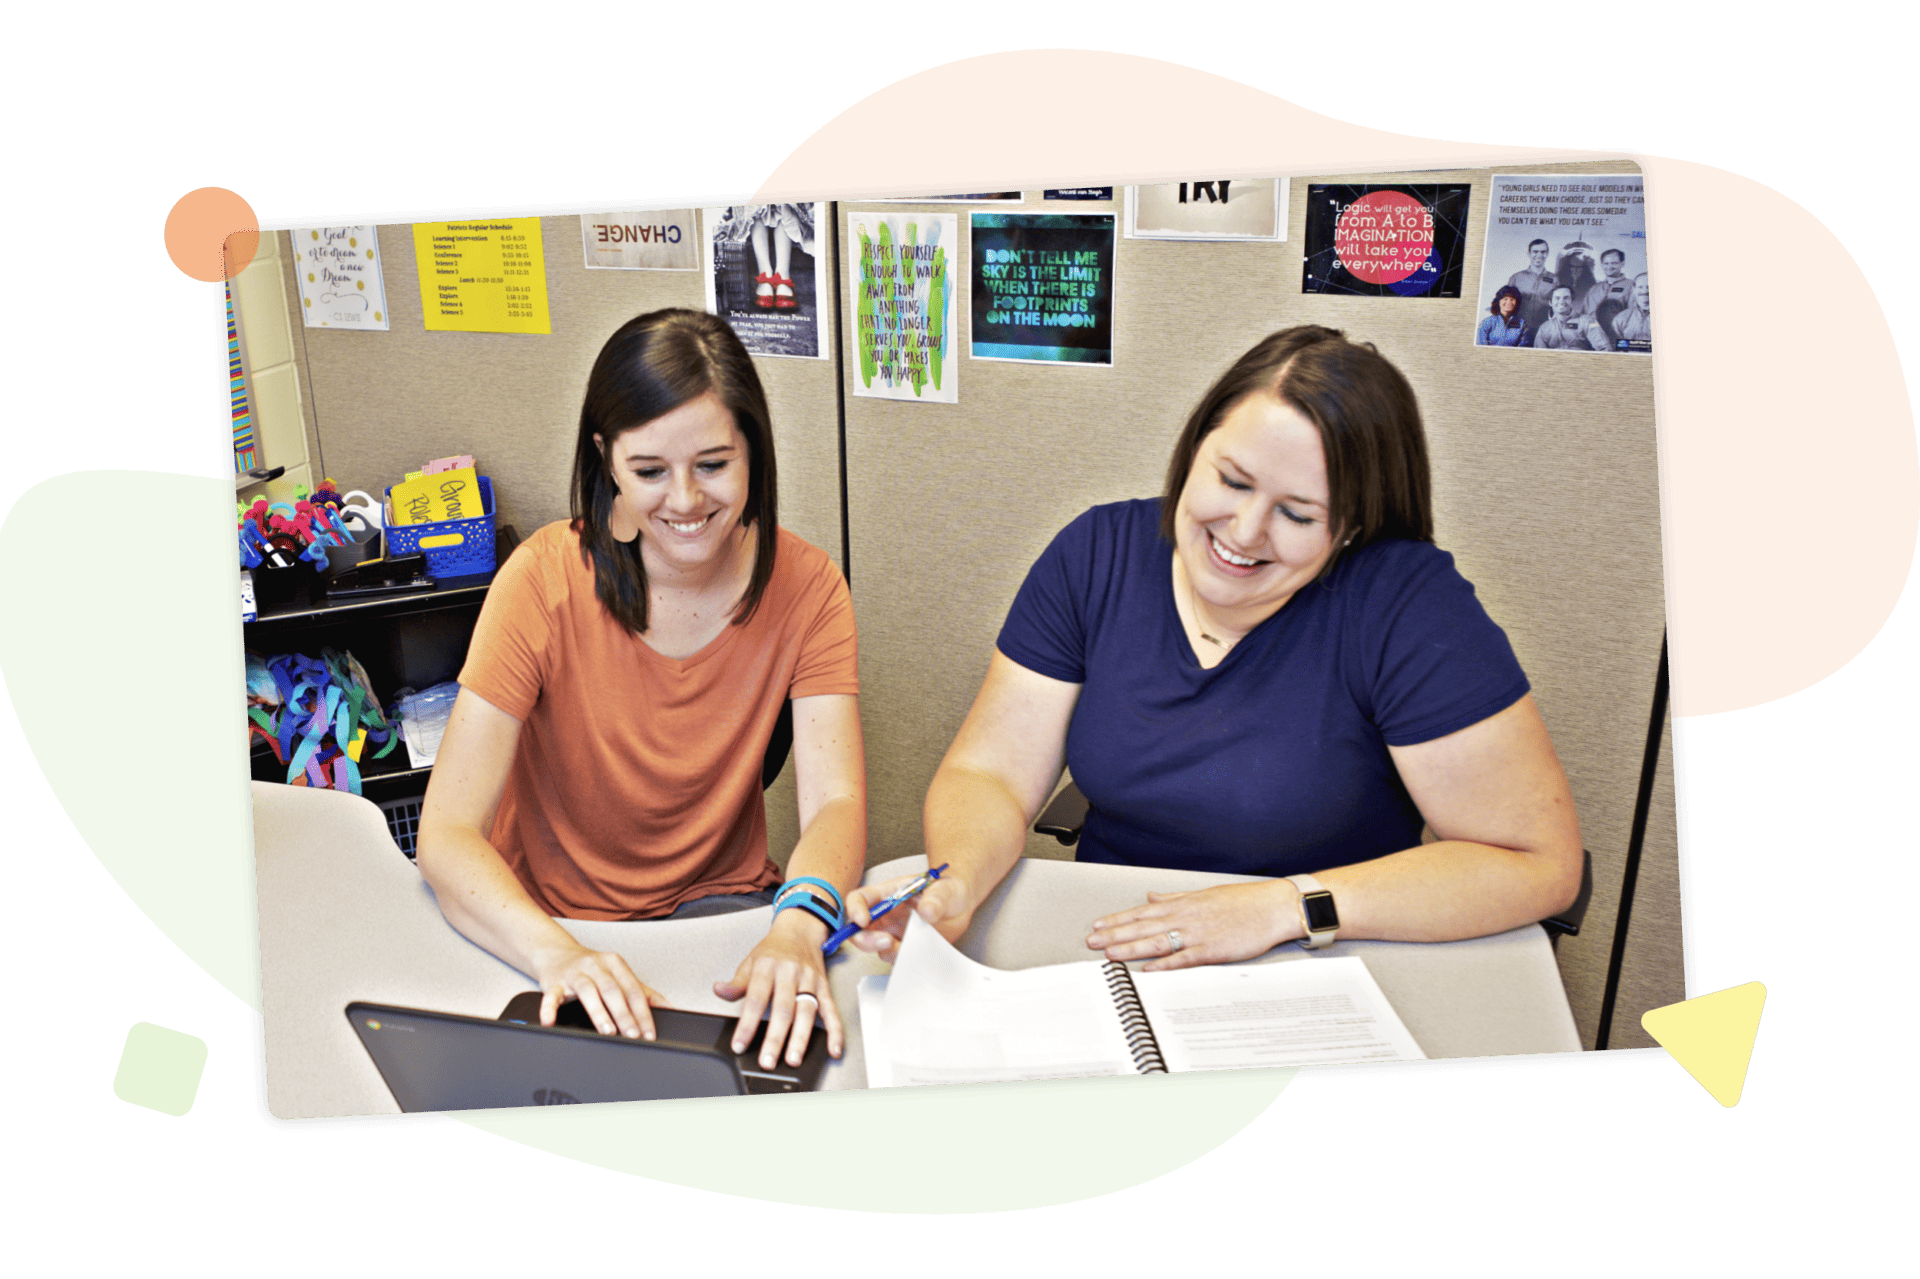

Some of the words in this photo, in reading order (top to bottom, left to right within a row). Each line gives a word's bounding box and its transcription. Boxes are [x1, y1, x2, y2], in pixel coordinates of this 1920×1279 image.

[1522, 184, 1540, 192] GIRLS
[1541, 184, 1558, 192] NEED
[1560, 184, 1568, 192] TO
[1568, 184, 1580, 192] SEE
[1582, 184, 1598, 192] ROLE
[1598, 184, 1625, 192] MODELS
[1626, 184, 1634, 192] IN
[1500, 195, 1528, 203] CAREERS
[1529, 195, 1545, 203] THEY
[1546, 195, 1560, 203] MAY
[1588, 196, 1604, 204] JUST
[1604, 196, 1614, 204] SO
[1614, 196, 1632, 204] THEY
[1374, 204, 1392, 212] will
[1394, 205, 1412, 215] get
[1414, 206, 1434, 214] you
[1499, 206, 1538, 214] THEMSELVES
[1539, 206, 1558, 214] DOING
[1559, 206, 1580, 214] THOSE
[1580, 206, 1596, 214] JOBS
[1335, 213, 1376, 227] from
[1382, 213, 1394, 228] A
[1400, 214, 1417, 228] to
[1498, 217, 1510, 225] YOU
[1530, 217, 1538, 225] BE
[1539, 217, 1558, 226] WHAT
[1558, 217, 1570, 226] YOU
[1334, 228, 1434, 242] IMAGINATION
[330, 246, 357, 263] dream
[864, 242, 894, 260] RESPECT
[900, 244, 938, 261] YOURSELF
[986, 248, 1035, 264] DON'T
[1040, 250, 1071, 265] TELL
[1074, 250, 1098, 266] ME
[1333, 244, 1360, 256] will
[1365, 244, 1398, 256] take
[1403, 246, 1432, 260] you
[321, 267, 352, 288] Dream
[866, 263, 898, 279] ENOUGH
[902, 264, 912, 278] TO
[916, 264, 942, 279] WALK
[982, 264, 1010, 278] SKY
[1012, 266, 1026, 279] IS
[1030, 266, 1058, 280] THE
[1060, 266, 1102, 281] LIMIT
[866, 283, 889, 300] AWAY
[894, 282, 915, 298] FROM
[983, 280, 1028, 294] WHEN
[1032, 281, 1078, 296] THERE
[1082, 282, 1096, 297] IS
[879, 300, 920, 314] ANYTHING
[993, 296, 1088, 312] FOOTPRINTS
[860, 314, 880, 330] THAT
[884, 316, 897, 330] NO
[898, 316, 933, 332] LONGER
[986, 310, 1010, 324] ON
[1013, 310, 1040, 326] THE
[1043, 312, 1096, 328] MOON
[865, 332, 892, 348] SERVES
[916, 332, 943, 351] GROWS
[869, 349, 884, 363] YOU
[888, 349, 900, 363] OR
[904, 351, 928, 365] MAKES
[879, 364, 892, 380] YOU
[896, 366, 923, 384] HAPPY
